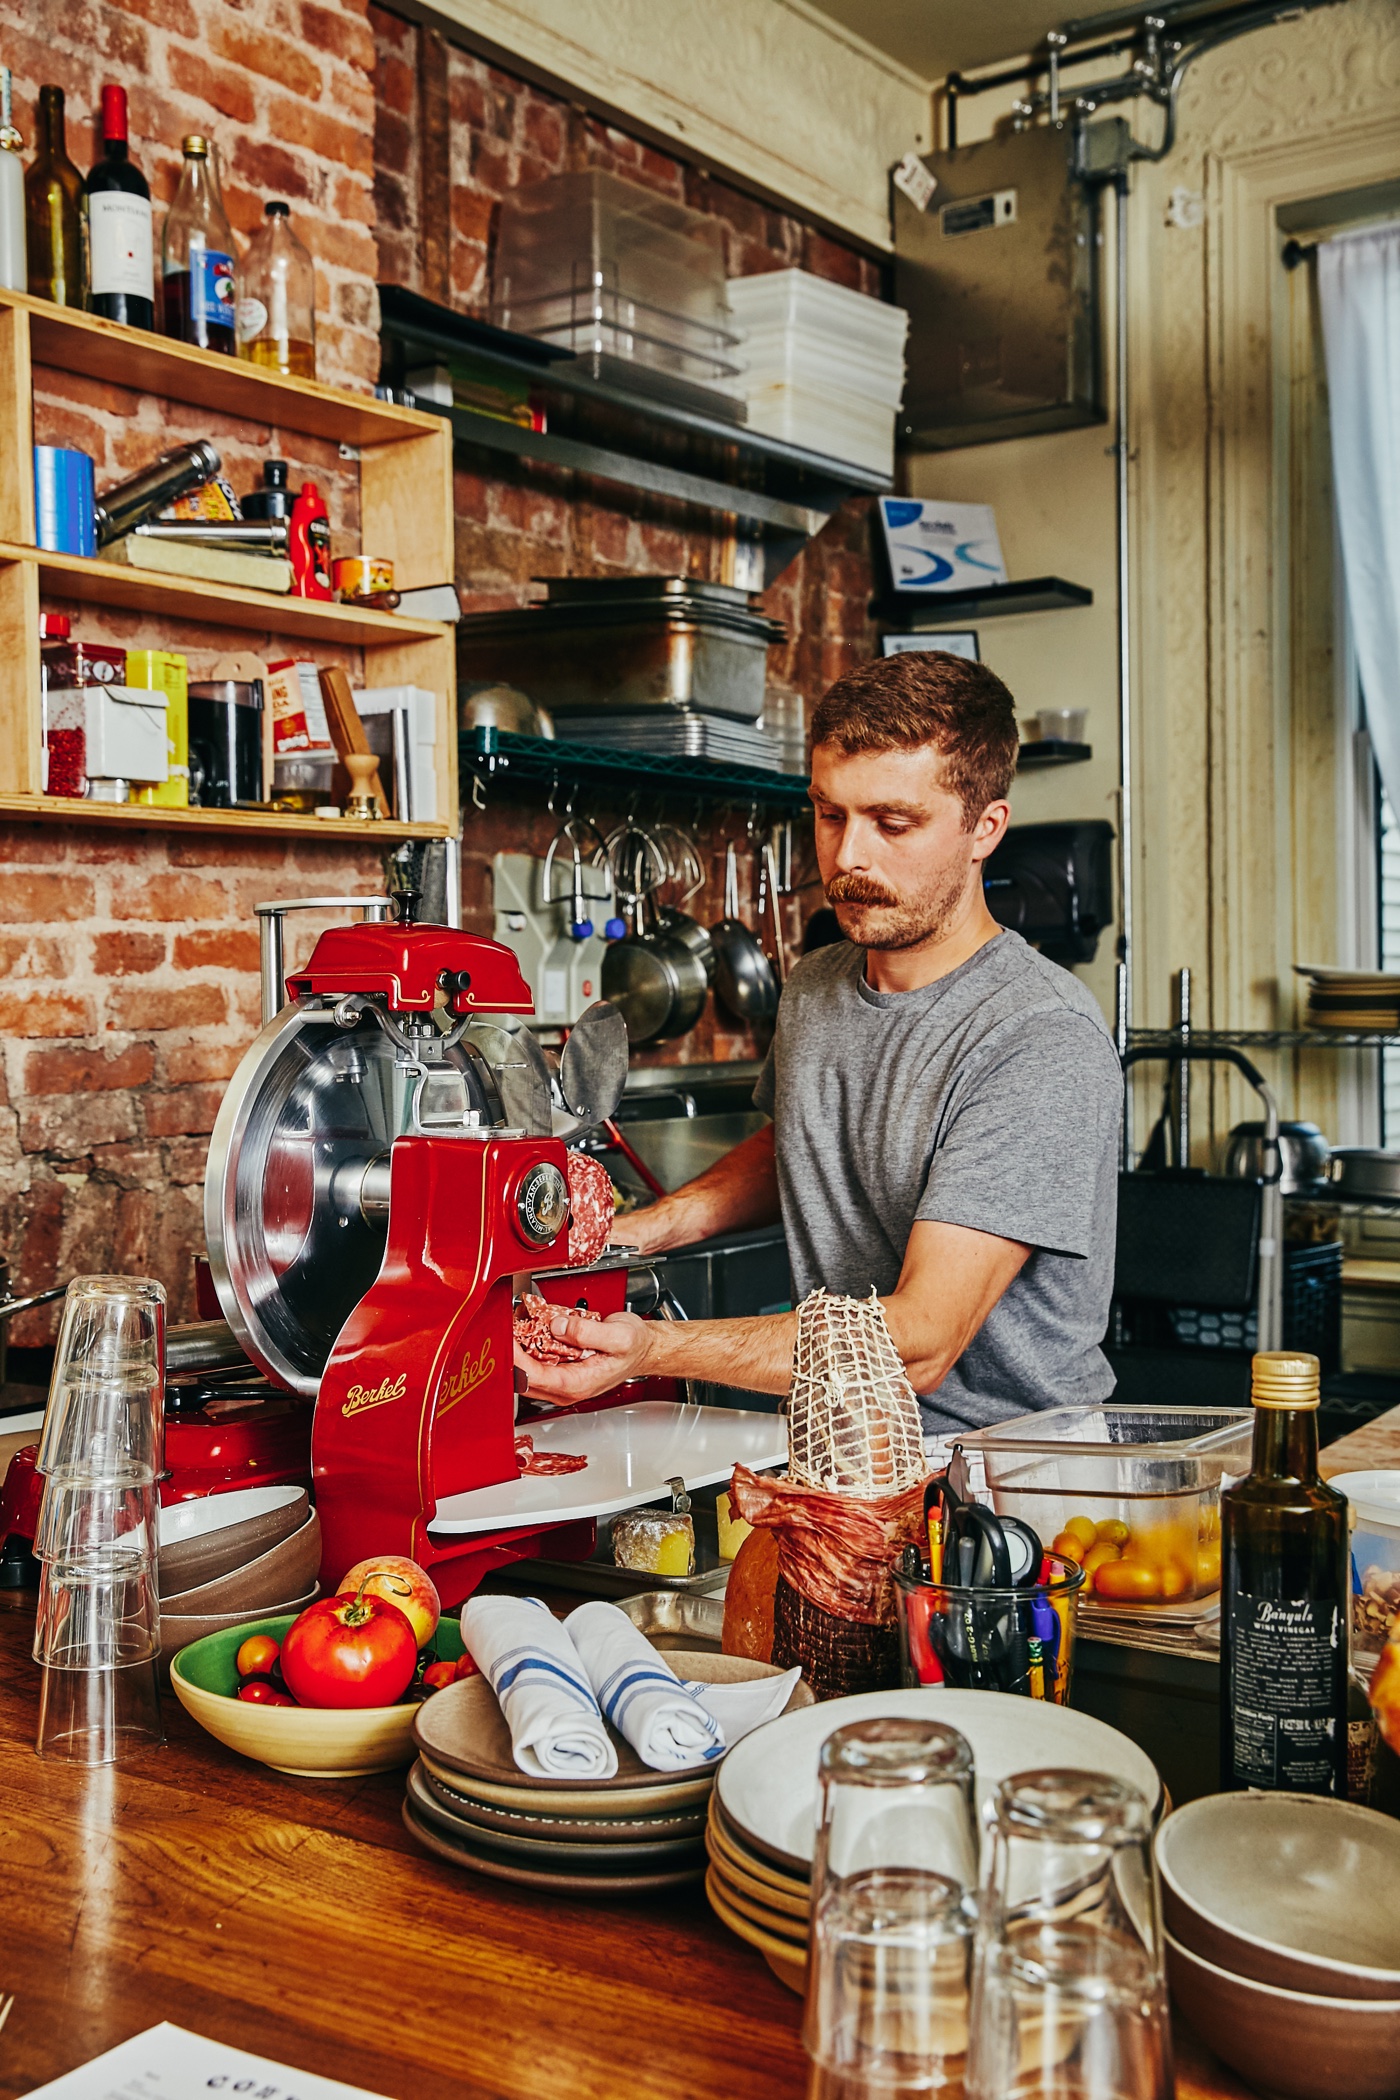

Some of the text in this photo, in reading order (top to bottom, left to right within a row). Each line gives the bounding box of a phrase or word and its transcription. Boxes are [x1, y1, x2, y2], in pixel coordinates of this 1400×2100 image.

[341, 1372, 407, 1418] Berkel
[437, 1337, 496, 1418] erkel
[1256, 1602, 1313, 1626] Banyuls
[1278, 1626, 1316, 1634] VINEGAR
